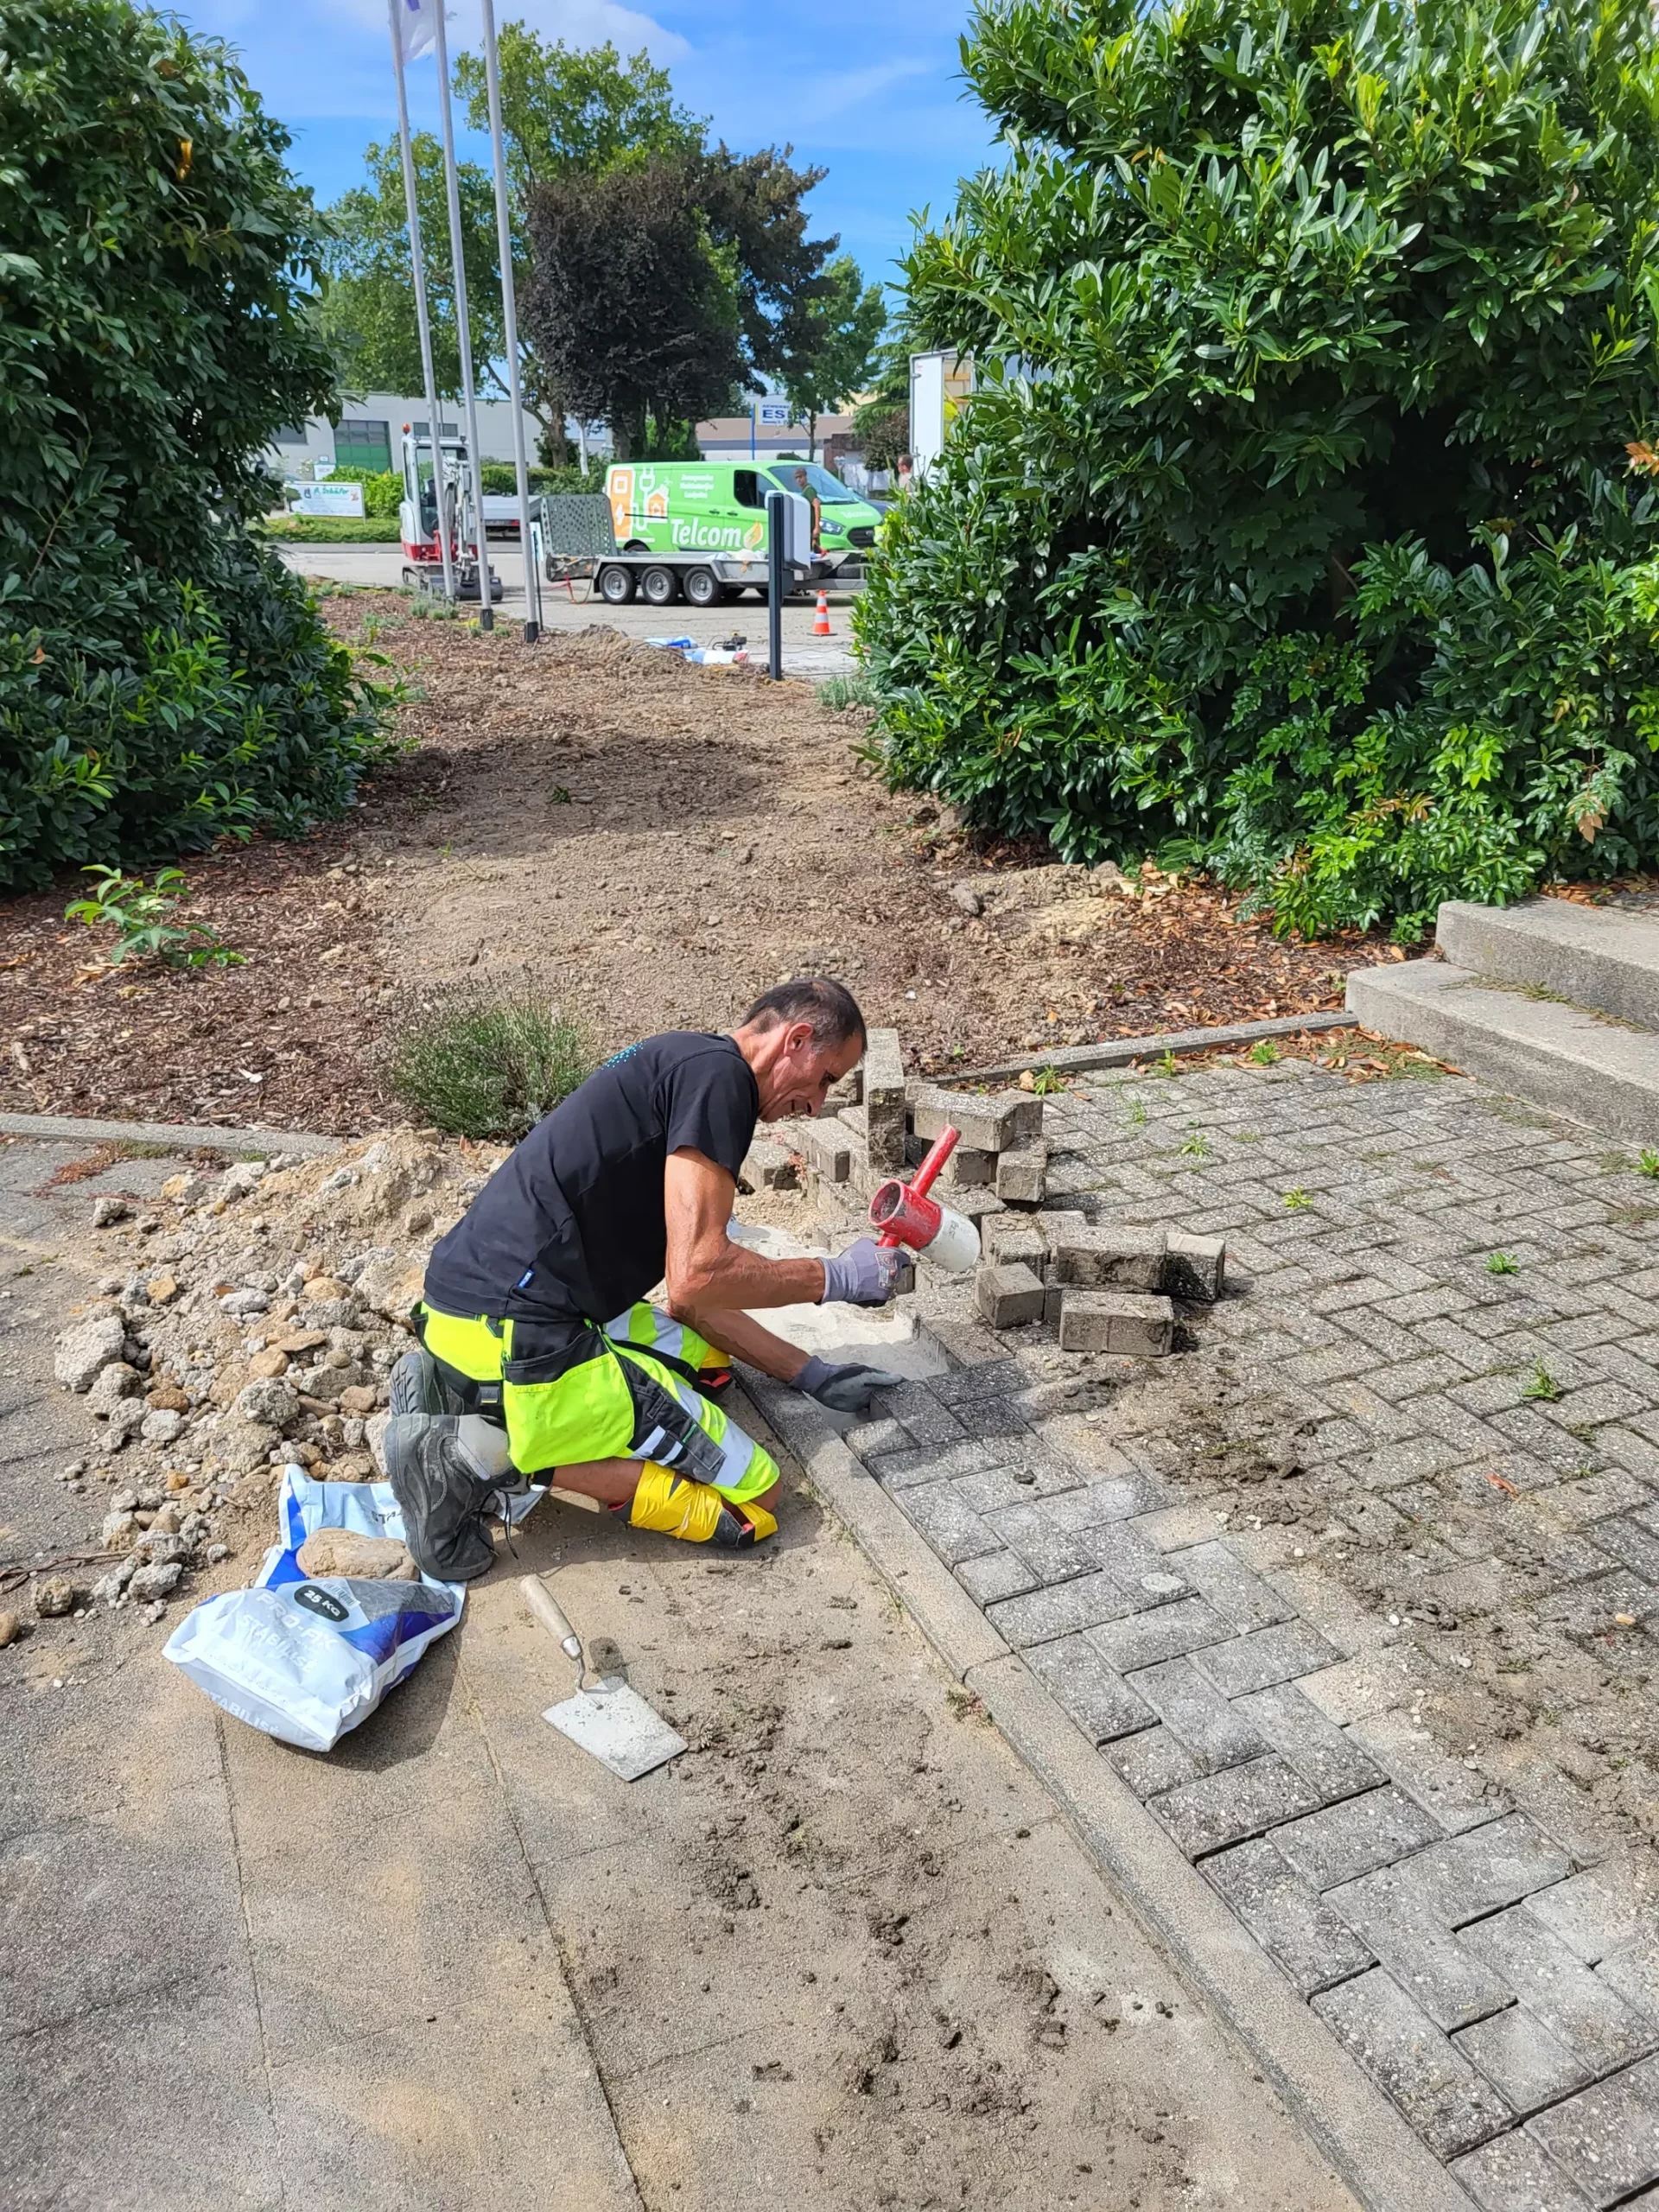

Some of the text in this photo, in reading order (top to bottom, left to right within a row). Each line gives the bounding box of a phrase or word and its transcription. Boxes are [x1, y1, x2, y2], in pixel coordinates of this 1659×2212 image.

[670, 517, 741, 547] Telcom
[304, 1590, 341, 1617] 25 KG
